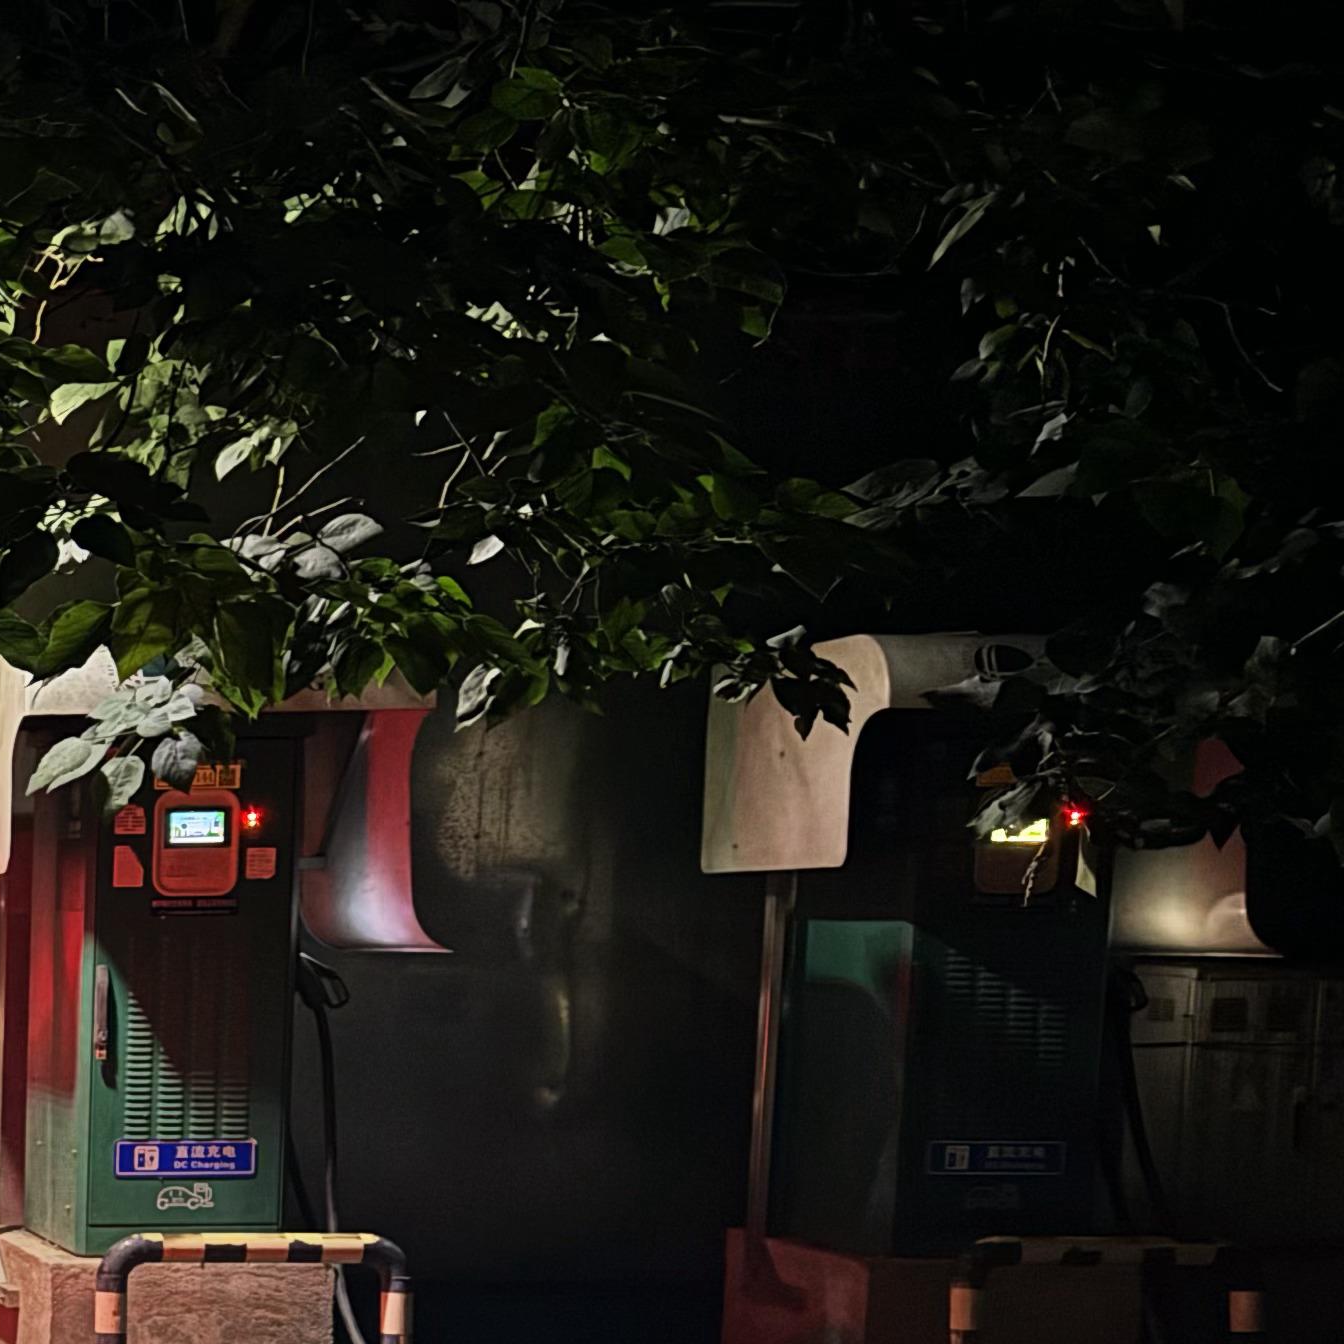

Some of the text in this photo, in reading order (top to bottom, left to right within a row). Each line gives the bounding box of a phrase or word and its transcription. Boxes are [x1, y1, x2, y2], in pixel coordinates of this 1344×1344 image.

[175, 1145, 237, 1159] 直流充电
[173, 1160, 236, 1170] DC Charging
